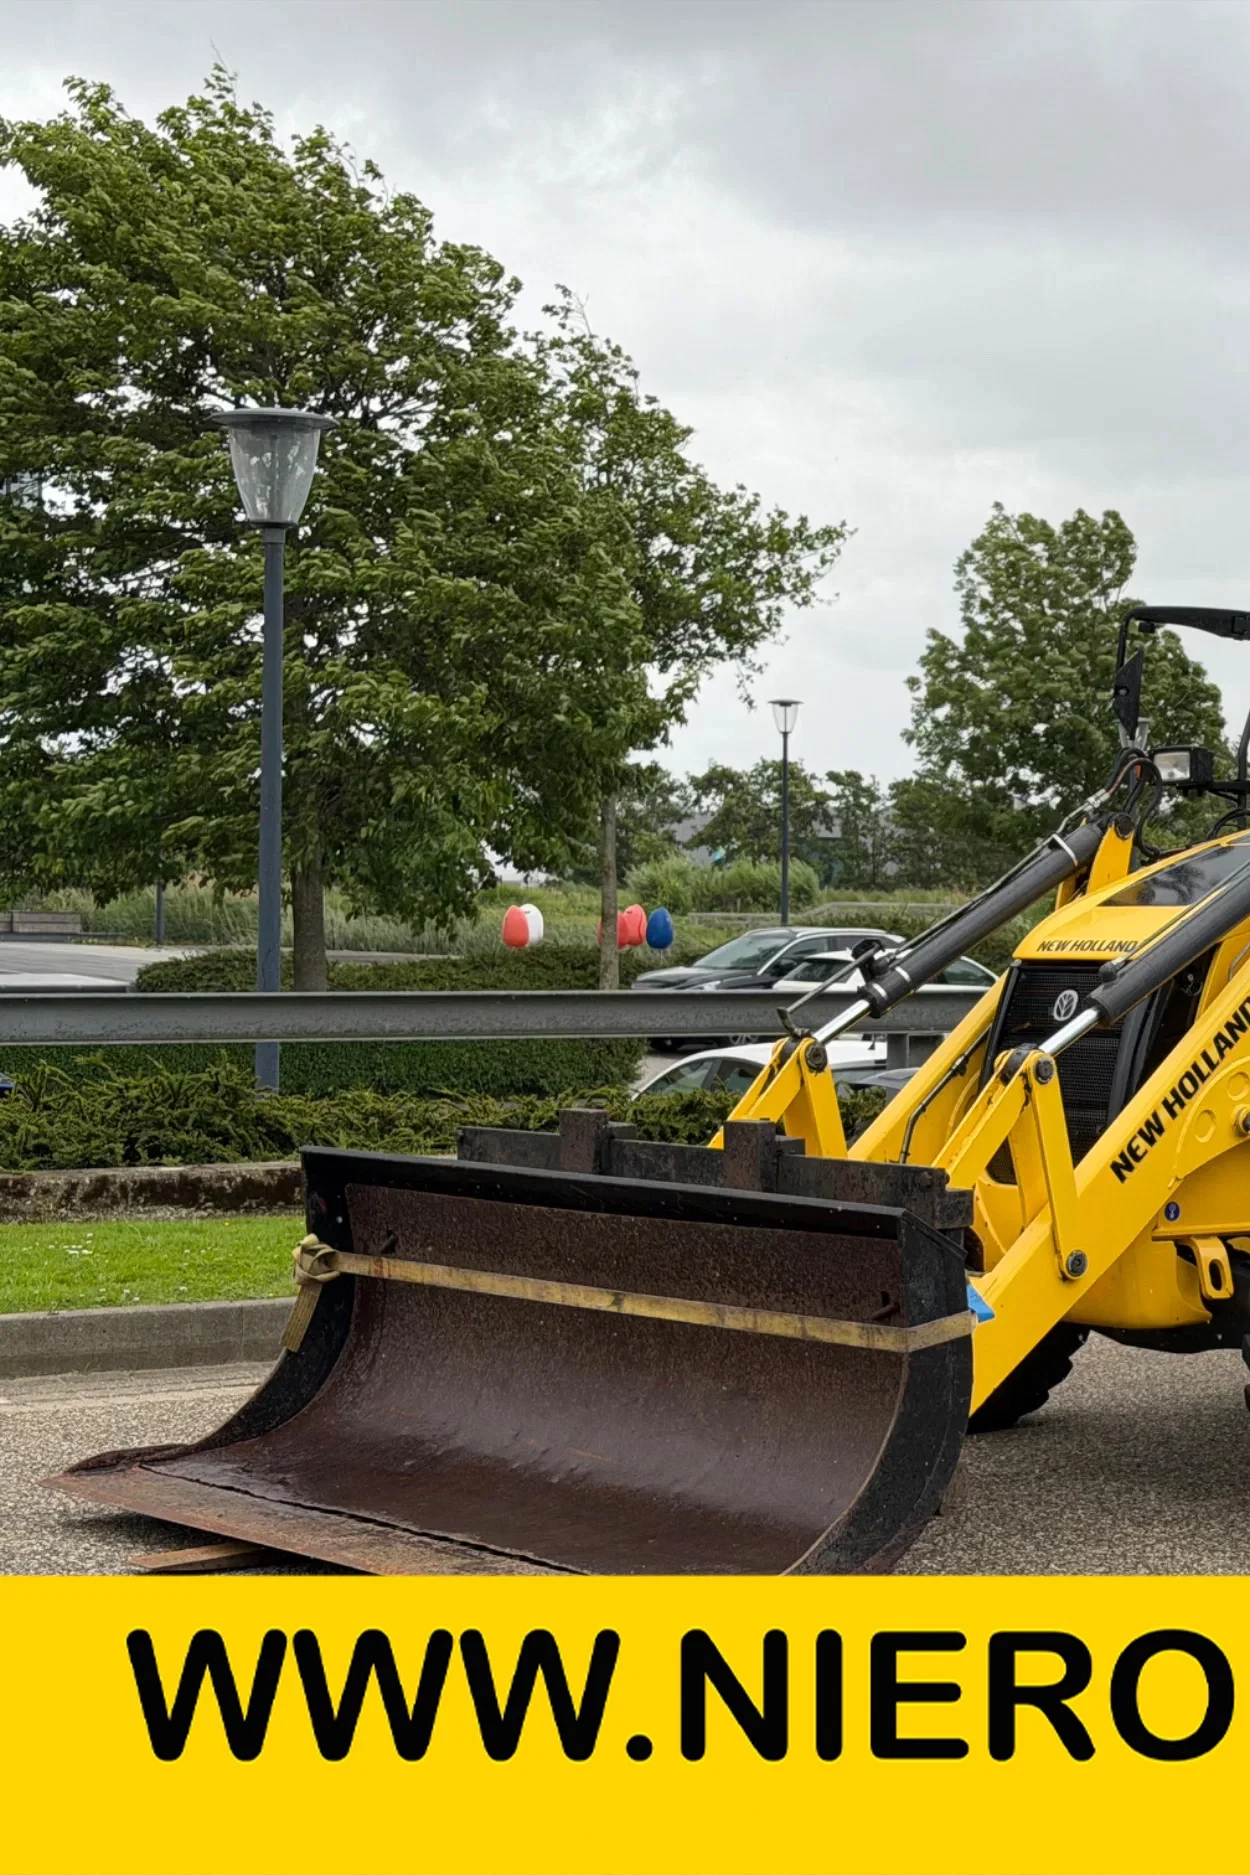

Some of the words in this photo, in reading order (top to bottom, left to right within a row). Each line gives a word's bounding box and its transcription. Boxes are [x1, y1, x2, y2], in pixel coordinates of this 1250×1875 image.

[1036, 939, 1070, 952] NEW
[1069, 939, 1139, 953] HOLLAND
[1109, 1109, 1166, 1184] NEW
